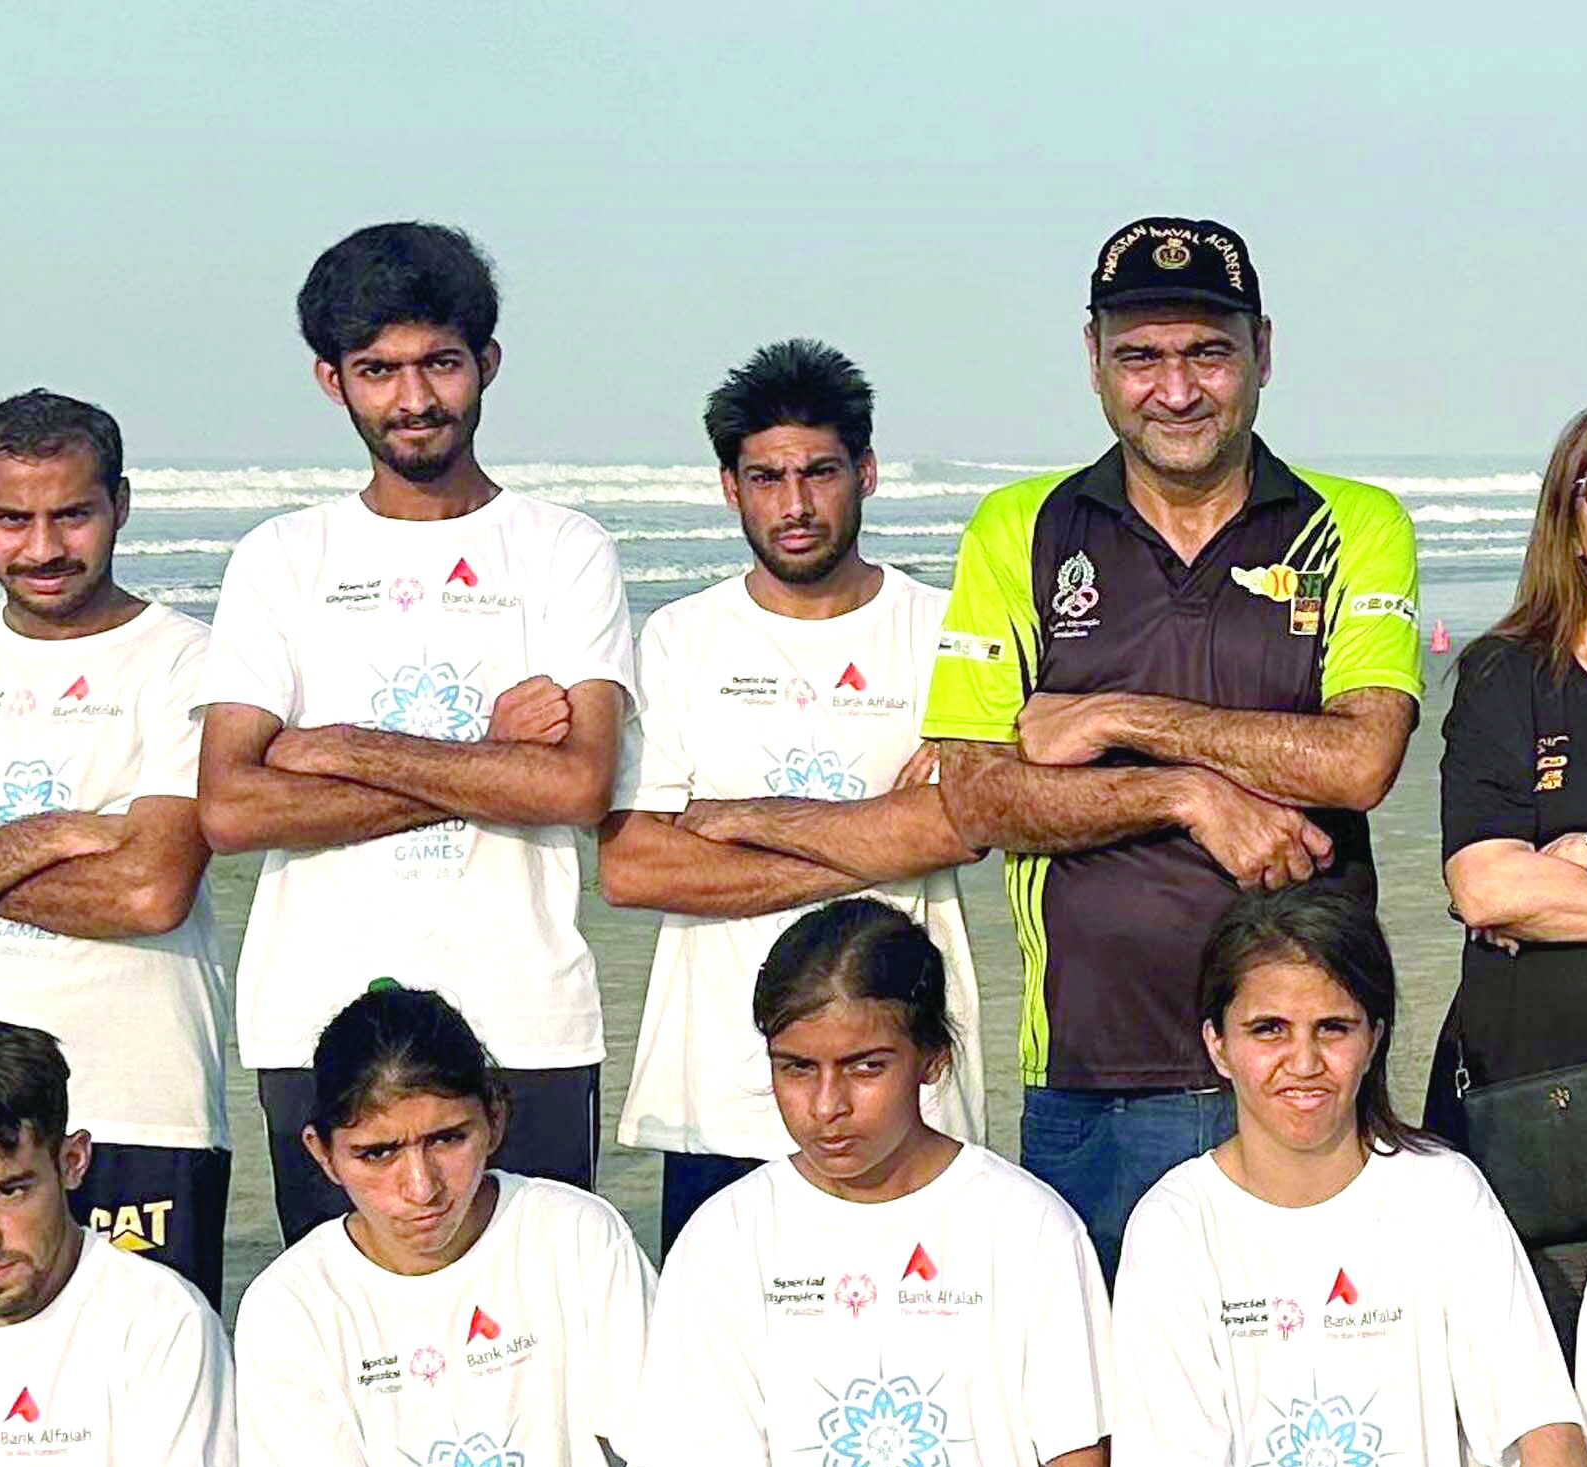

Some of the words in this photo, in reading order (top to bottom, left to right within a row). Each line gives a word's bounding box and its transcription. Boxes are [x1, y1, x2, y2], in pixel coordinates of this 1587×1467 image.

[1101, 224, 1148, 284] PAKISTAN
[1149, 224, 1201, 246] NAVAL
[1203, 232, 1245, 293] ACADEMY
[395, 845, 465, 861] GAMES
[466, 1347, 501, 1369] Bank
[1, 1431, 34, 1445] Bank
